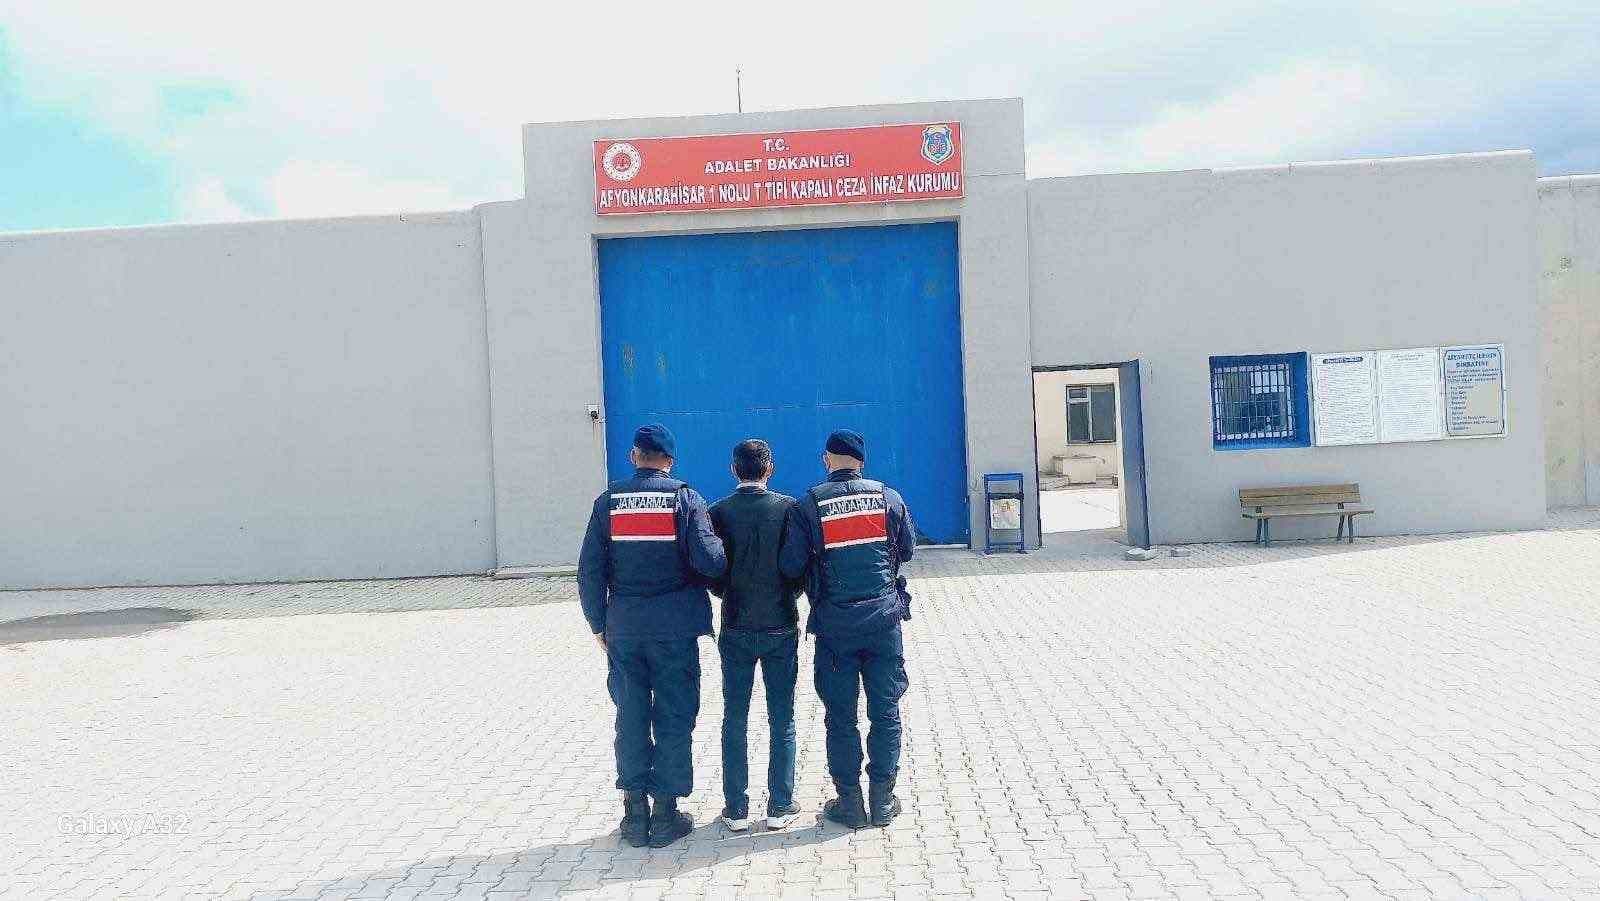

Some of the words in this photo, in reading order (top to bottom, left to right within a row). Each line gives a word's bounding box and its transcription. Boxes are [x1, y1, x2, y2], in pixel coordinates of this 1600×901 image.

[763, 137, 790, 152] T.C.
[704, 159, 762, 174] ADALET
[767, 152, 850, 170] BAKANLIĞI
[599, 183, 705, 208] AFYONKARAHİSAR
[708, 187, 715, 202] 1
[719, 184, 750, 203] NOLU
[754, 182, 763, 201] T
[790, 178, 833, 200] KAPALI
[836, 176, 867, 197] CEZA
[870, 172, 905, 195] İNFAZ
[907, 171, 961, 193] KURUMU
[615, 496, 667, 509] JANDARMA
[826, 497, 879, 516] JANDARMA
